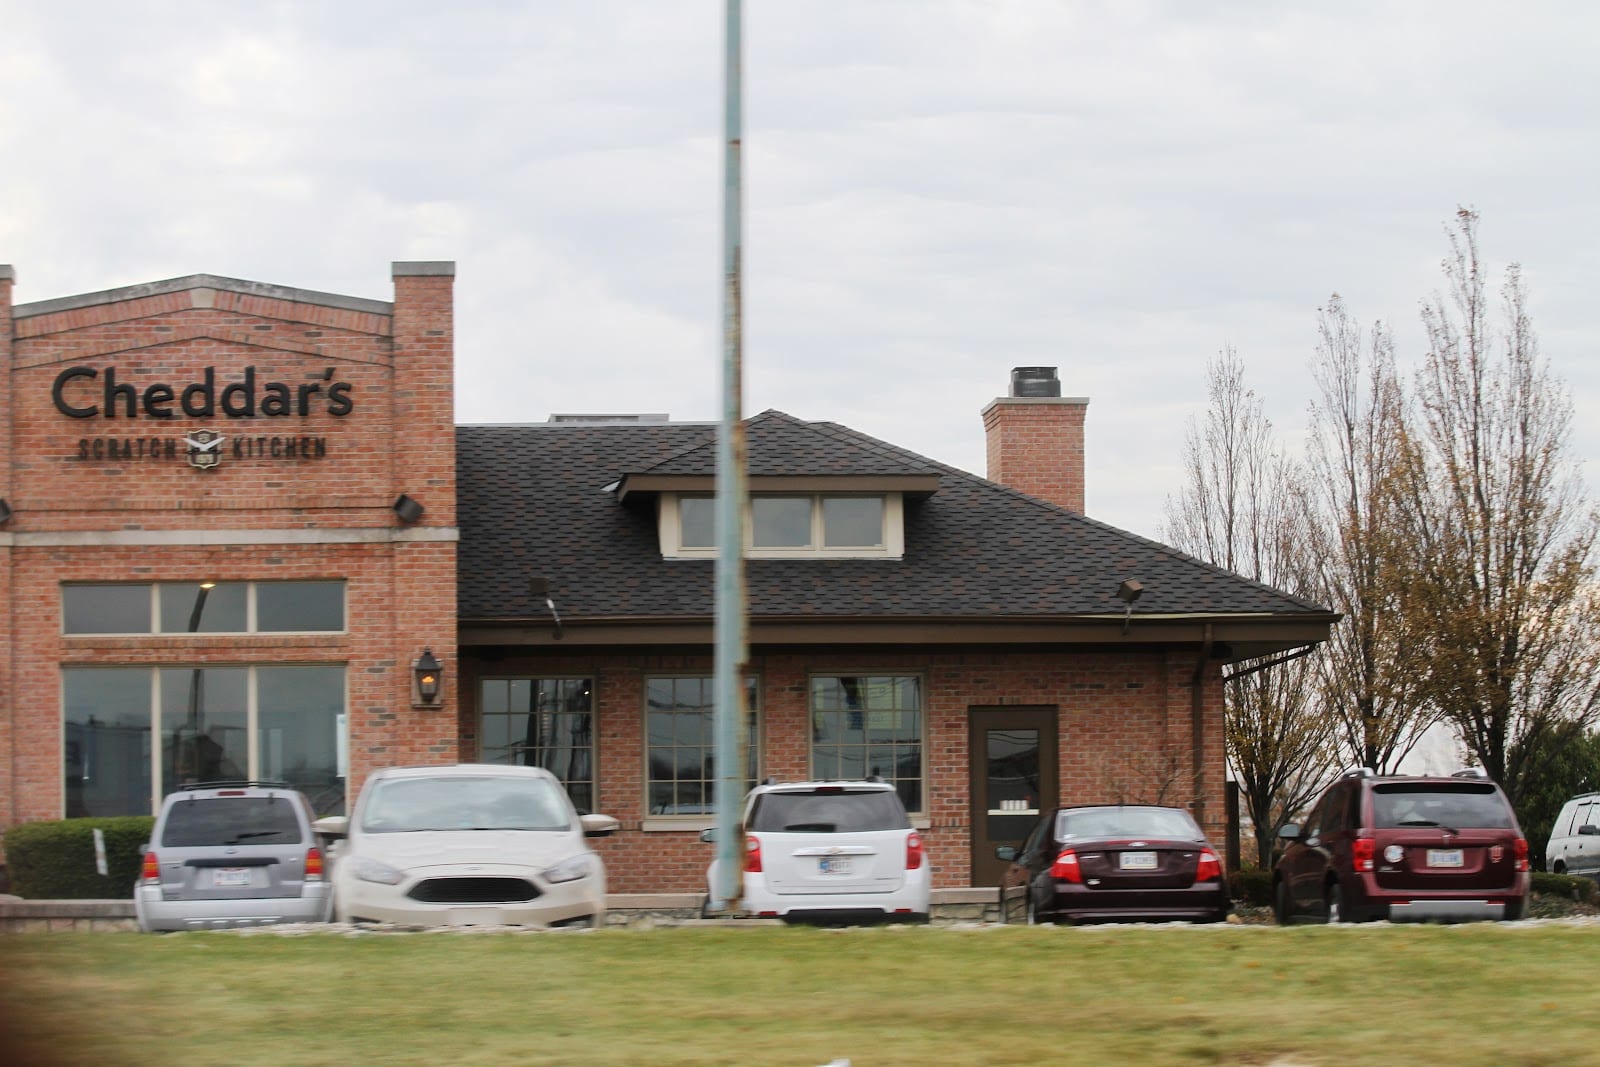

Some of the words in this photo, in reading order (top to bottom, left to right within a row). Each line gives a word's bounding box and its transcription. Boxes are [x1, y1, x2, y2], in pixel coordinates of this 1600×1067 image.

[52, 366, 353, 418] Cheddar's
[78, 438, 177, 461] SCRATCH
[233, 436, 327, 458] KITCHEN
